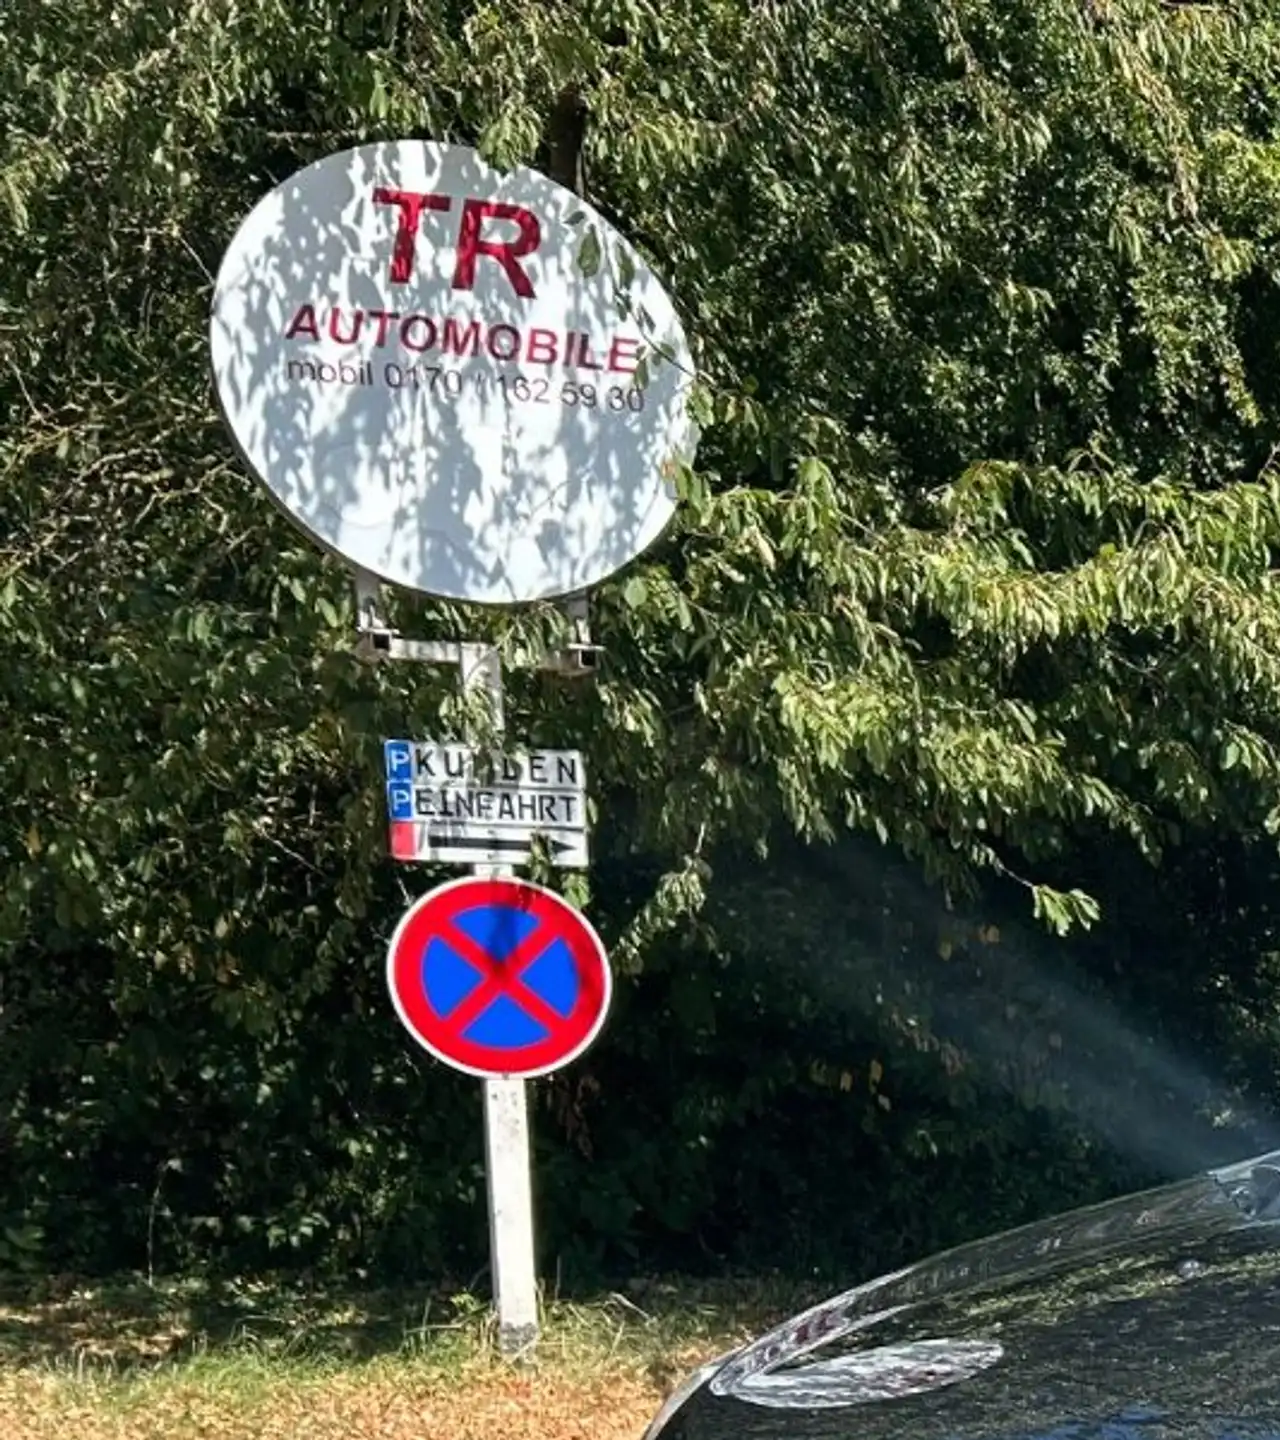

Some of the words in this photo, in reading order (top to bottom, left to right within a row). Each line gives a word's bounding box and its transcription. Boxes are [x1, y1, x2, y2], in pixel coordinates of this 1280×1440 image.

[372, 187, 543, 298] TR
[285, 303, 641, 375] AUTOMOBILE
[287, 359, 374, 387] mobil
[384, 363, 462, 395] 0170
[497, 374, 550, 404] 162
[560, 381, 597, 408] 59
[609, 386, 645, 413] 30
[415, 787, 578, 823] EINFAHRT
